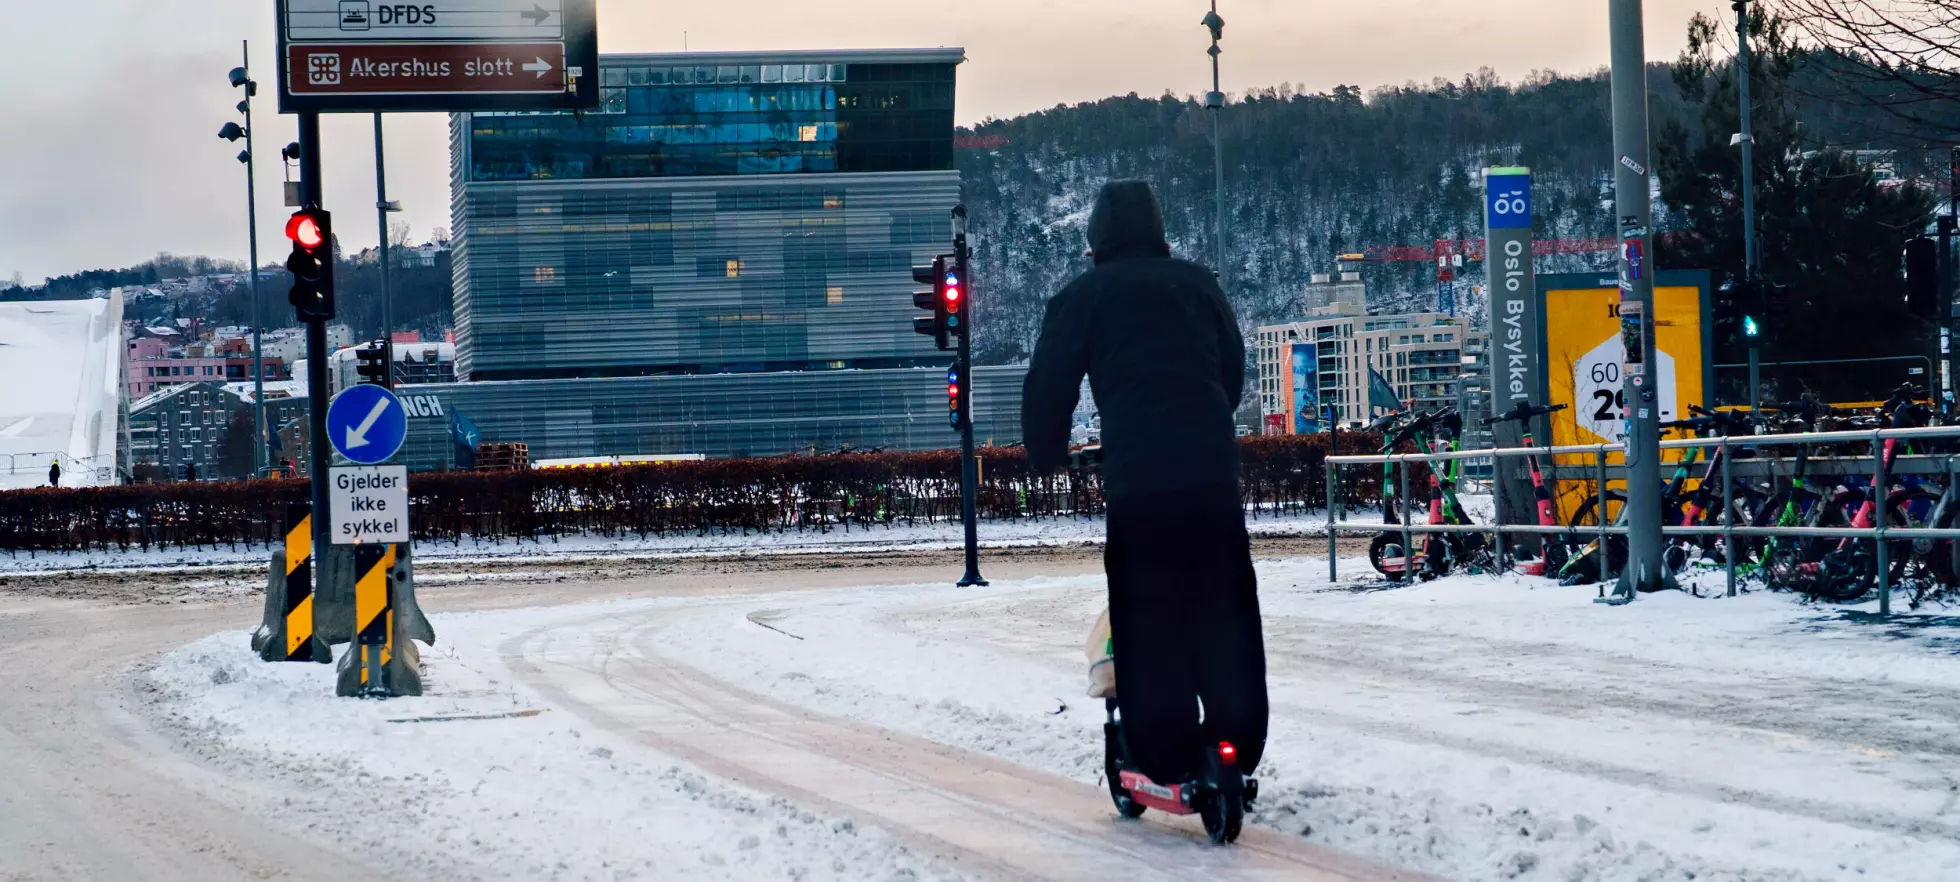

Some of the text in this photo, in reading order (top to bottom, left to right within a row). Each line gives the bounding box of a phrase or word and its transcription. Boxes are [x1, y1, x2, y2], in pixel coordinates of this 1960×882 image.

[379, 5, 436, 24] DFDS
[350, 56, 514, 77] Akershus slott
[1502, 240, 1529, 400] Oslo Bysykkel
[1591, 362, 1619, 383] 60
[337, 473, 399, 493] Gjelder
[351, 497, 387, 512] ikke
[343, 518, 398, 537] sykkel
